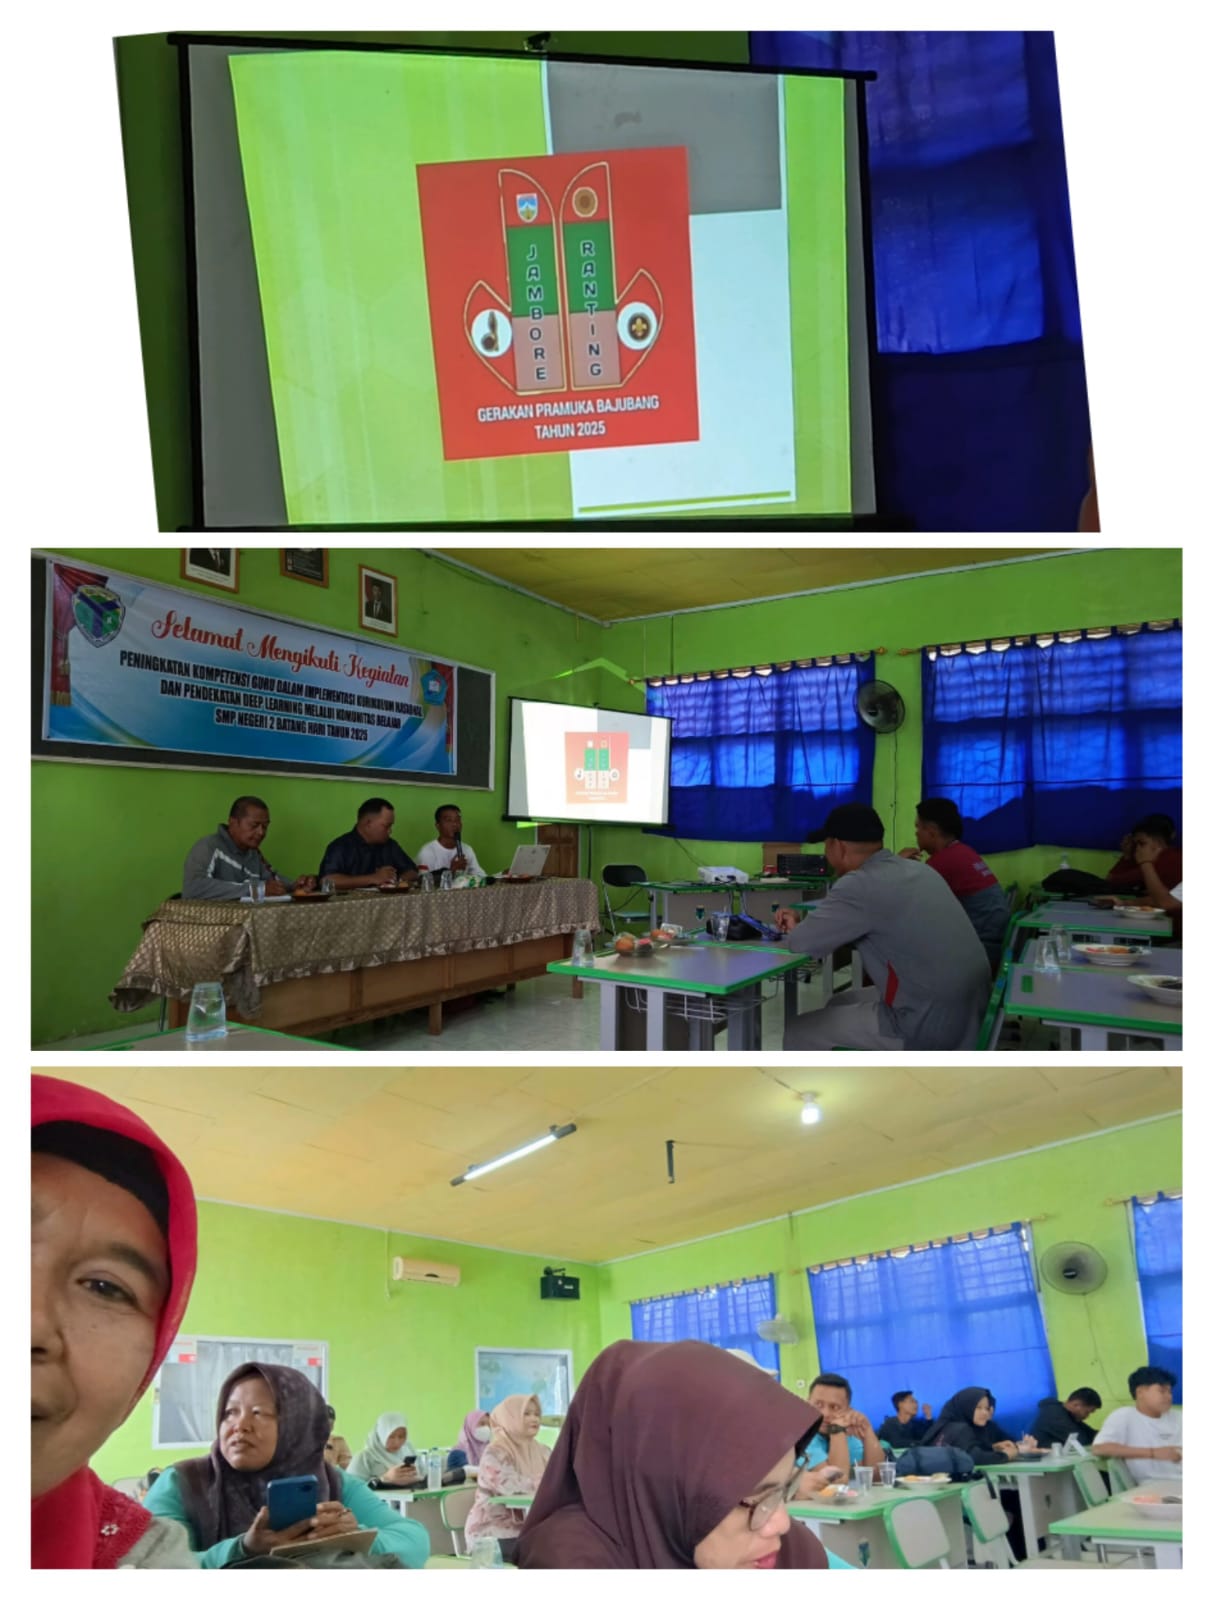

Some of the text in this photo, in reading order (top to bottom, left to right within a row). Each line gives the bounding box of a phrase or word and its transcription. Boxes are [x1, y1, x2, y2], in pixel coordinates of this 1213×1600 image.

[525, 244, 547, 381] JAMBORE
[581, 241, 602, 377] RANTING
[477, 395, 660, 422] GERAKAN PRAMUKA BAJUBANG
[535, 420, 606, 439] TAHUN 2025
[151, 609, 410, 688] Selamat Mengikuti Kegiatan
[119, 650, 190, 677] PENINGKATAN
[192, 663, 250, 688] KOMPETENSI
[251, 674, 276, 692] GURU
[276, 679, 304, 697] DALAM
[304, 684, 356, 706] IMPLEMENTASI
[160, 679, 182, 697] DAN
[183, 682, 241, 705] PENDEKATAN
[242, 692, 264, 709] DEEP
[264, 695, 304, 715] LEARNING
[304, 702, 335, 721] MELALUI
[335, 708, 376, 726] KOMUNITAS
[215, 708, 368, 741] SMP NEGERI 2 BATANG HARI TAHUN 2025
